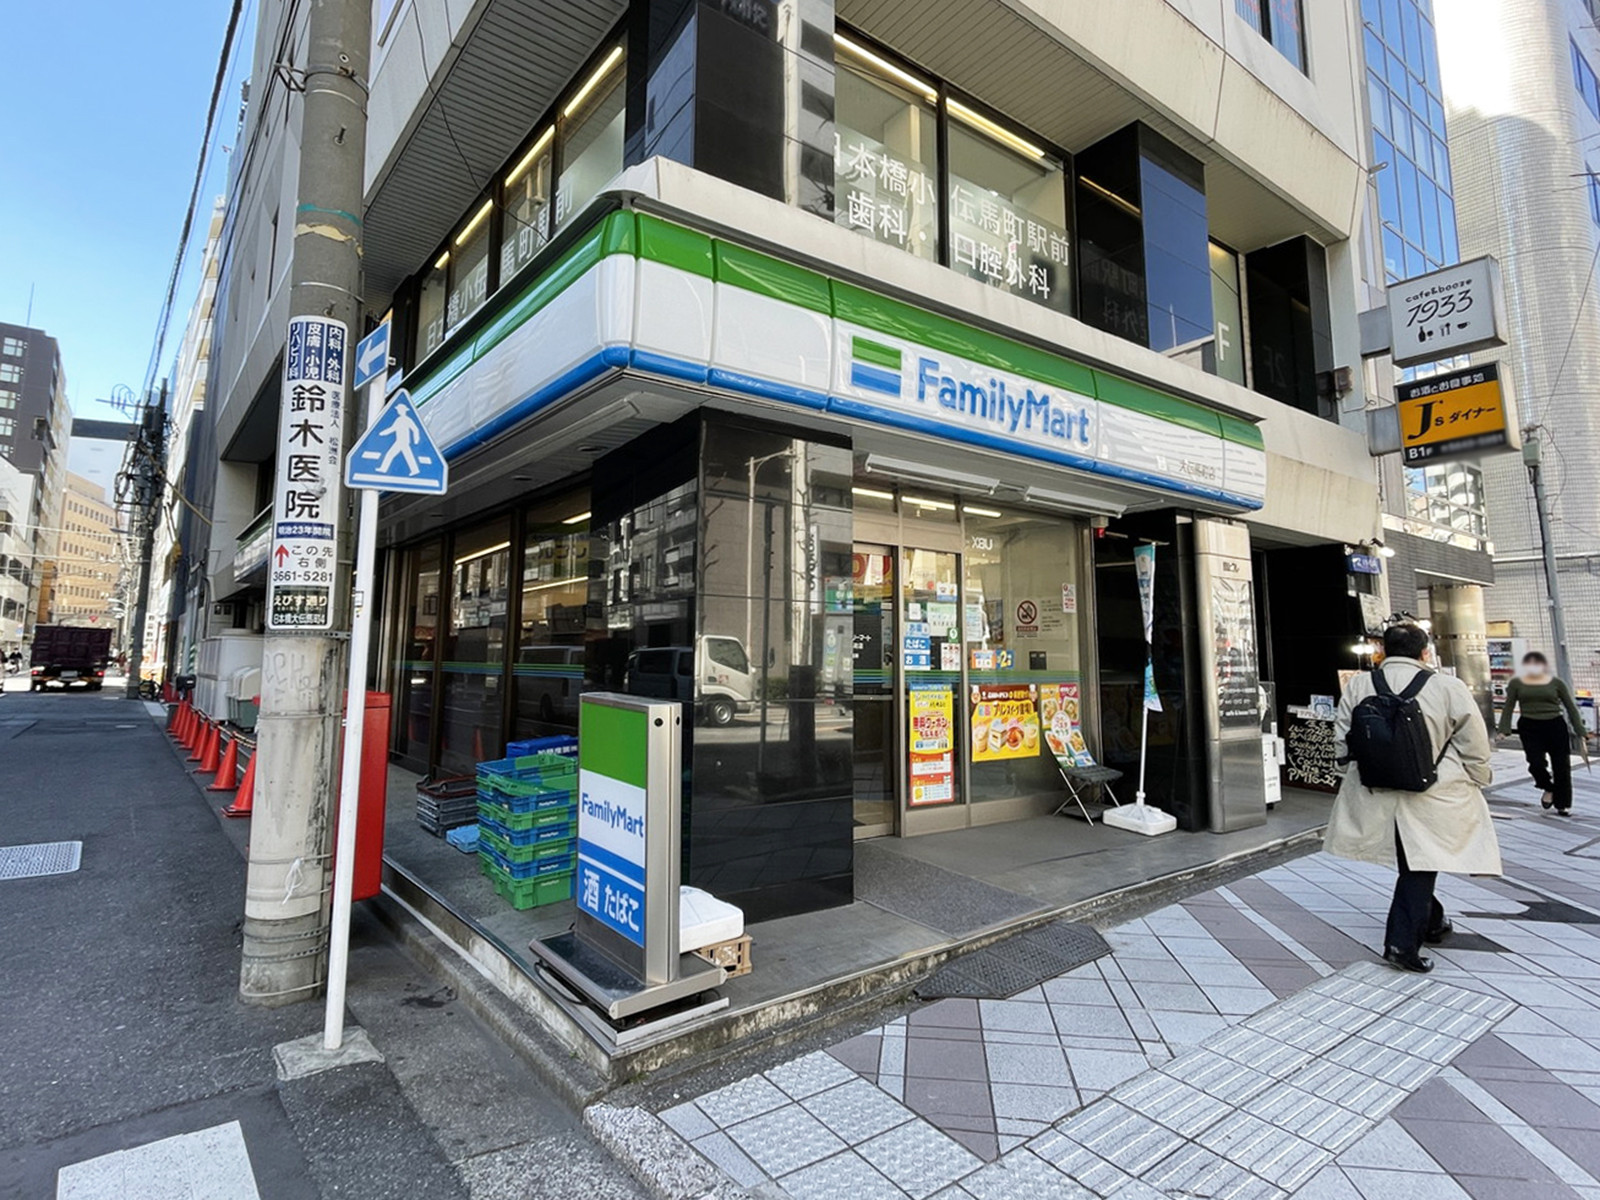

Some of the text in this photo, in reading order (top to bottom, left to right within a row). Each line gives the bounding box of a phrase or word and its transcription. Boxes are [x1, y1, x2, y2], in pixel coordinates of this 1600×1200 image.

[1406, 278, 1473, 303] cafe&booze
[1407, 289, 1473, 328] 1933
[289, 323, 301, 379] リハビリ科
[305, 323, 322, 379] 皮膚・小児
[326, 327, 342, 383] 内科・外科
[916, 356, 1090, 444] FamilyMart
[1410, 373, 1485, 398] お酒とお食事処
[330, 390, 341, 428] 医療法人
[1449, 407, 1496, 424] ダイナー
[285, 384, 326, 519] 鈴木医院
[291, 545, 333, 557] この先
[297, 557, 327, 569] 右側
[272, 570, 333, 582] 3661-5281
[273, 594, 327, 607] えびす通り
[905, 638, 926, 650] たばこ
[581, 792, 645, 838] FamilyMart
[583, 868, 640, 932] 酒 たばこ
